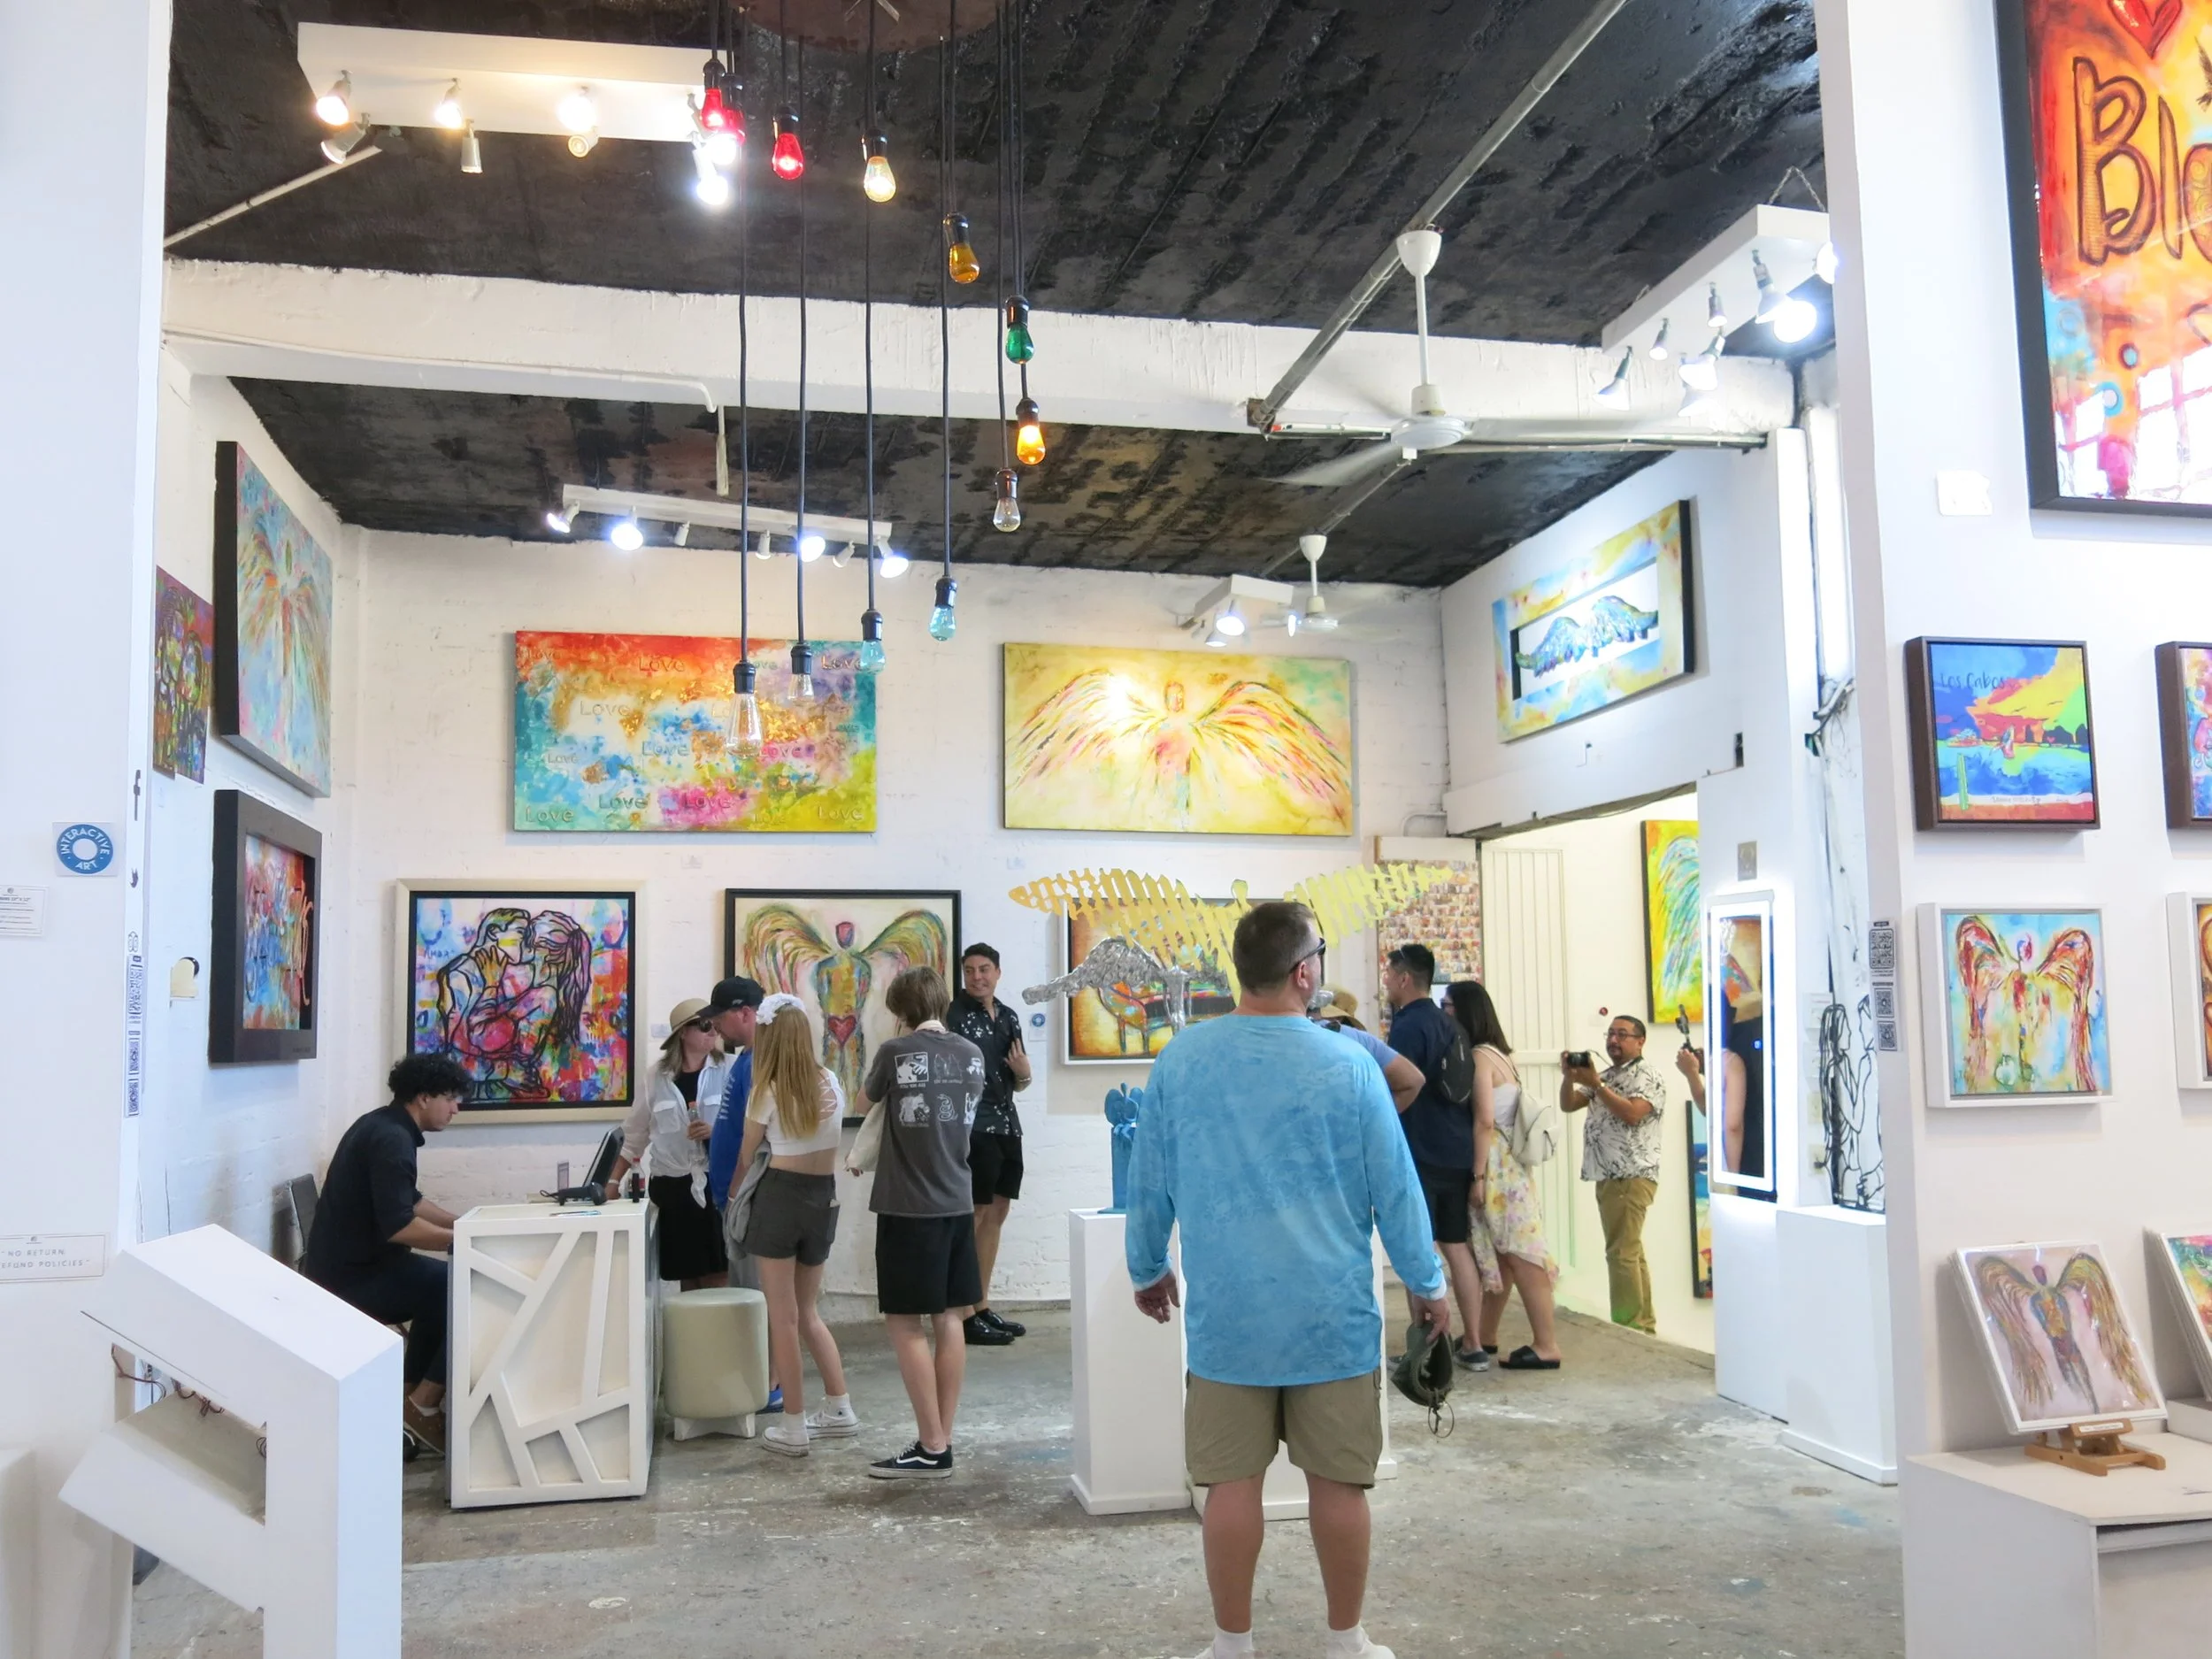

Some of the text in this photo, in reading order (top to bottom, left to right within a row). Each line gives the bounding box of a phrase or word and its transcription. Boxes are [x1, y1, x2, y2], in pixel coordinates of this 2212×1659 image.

[638, 655, 687, 672] Love
[820, 655, 864, 672] Love
[1940, 672, 2006, 690] Los Cabos
[580, 700, 631, 718] Love
[828, 721, 861, 733] Love
[641, 740, 690, 757] Love
[547, 753, 580, 764] Love
[598, 793, 649, 810] Love
[683, 792, 732, 809] Love
[526, 806, 574, 823] Love
[818, 805, 864, 822] Love
[60, 827, 111, 856] INTERACTIVE
[74, 860, 97, 871] ART
